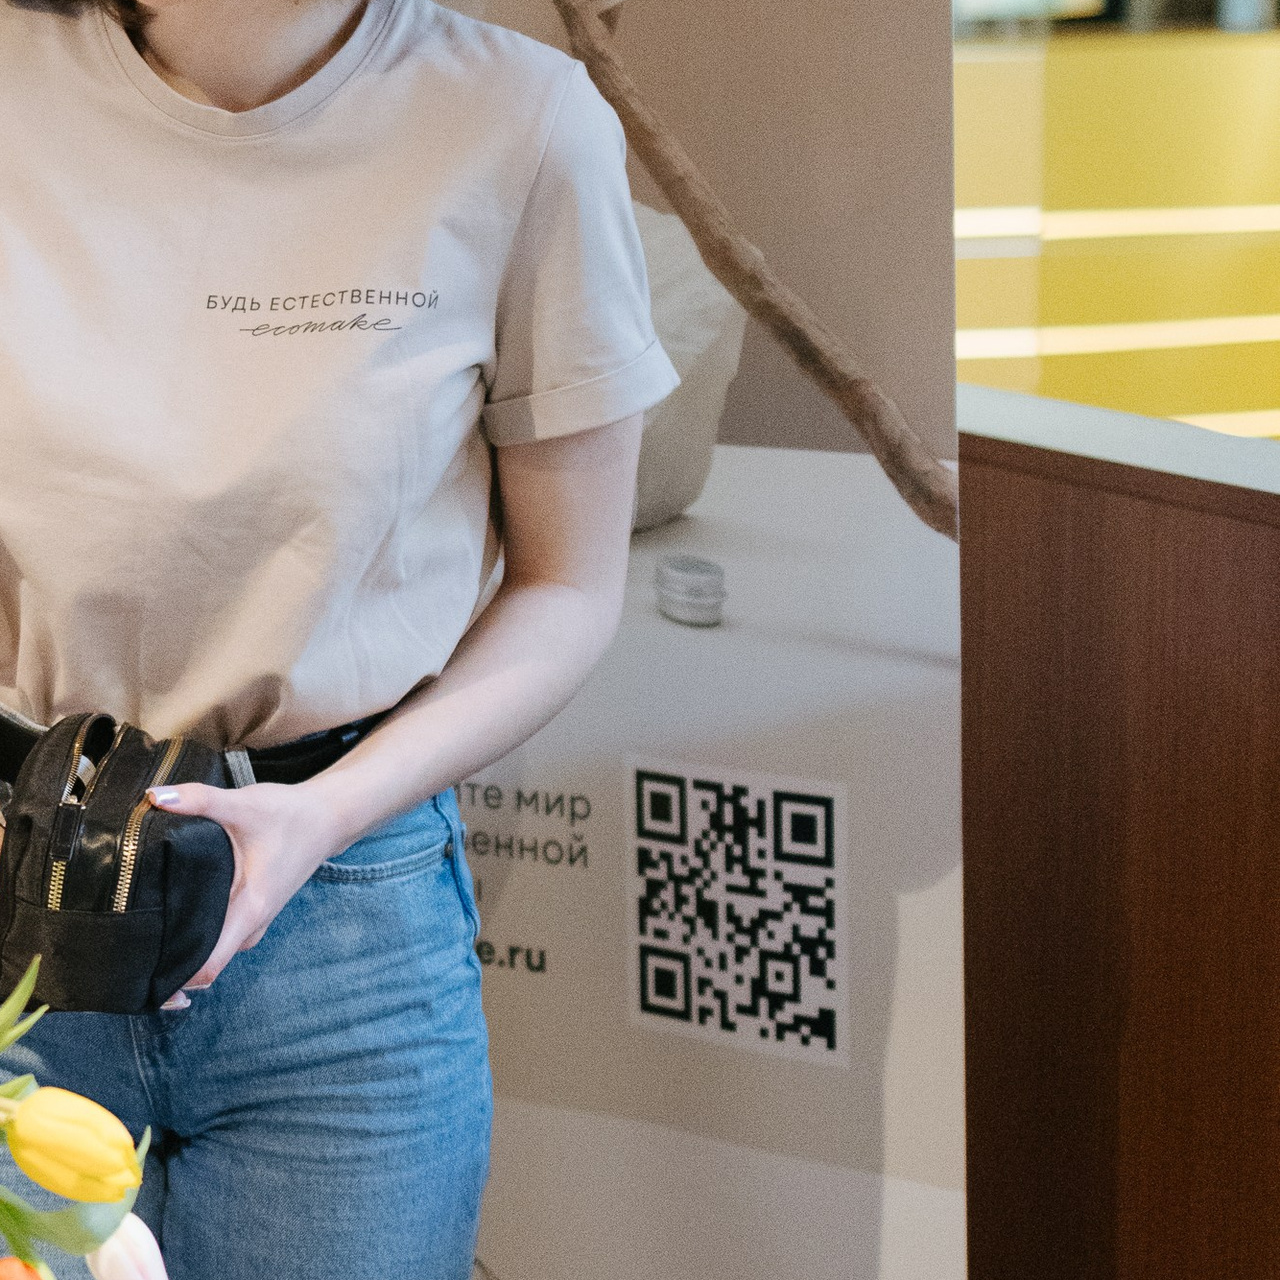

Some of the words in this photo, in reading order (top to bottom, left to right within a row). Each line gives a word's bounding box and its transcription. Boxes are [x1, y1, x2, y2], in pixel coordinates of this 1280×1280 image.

[206, 294, 261, 313] БУДЬ
[270, 288, 439, 312] ЕСТЕСТВЕННОЙ
[239, 313, 403, 337] ecomake
[516, 788, 592, 827] мир
[475, 940, 548, 974] e.ru
